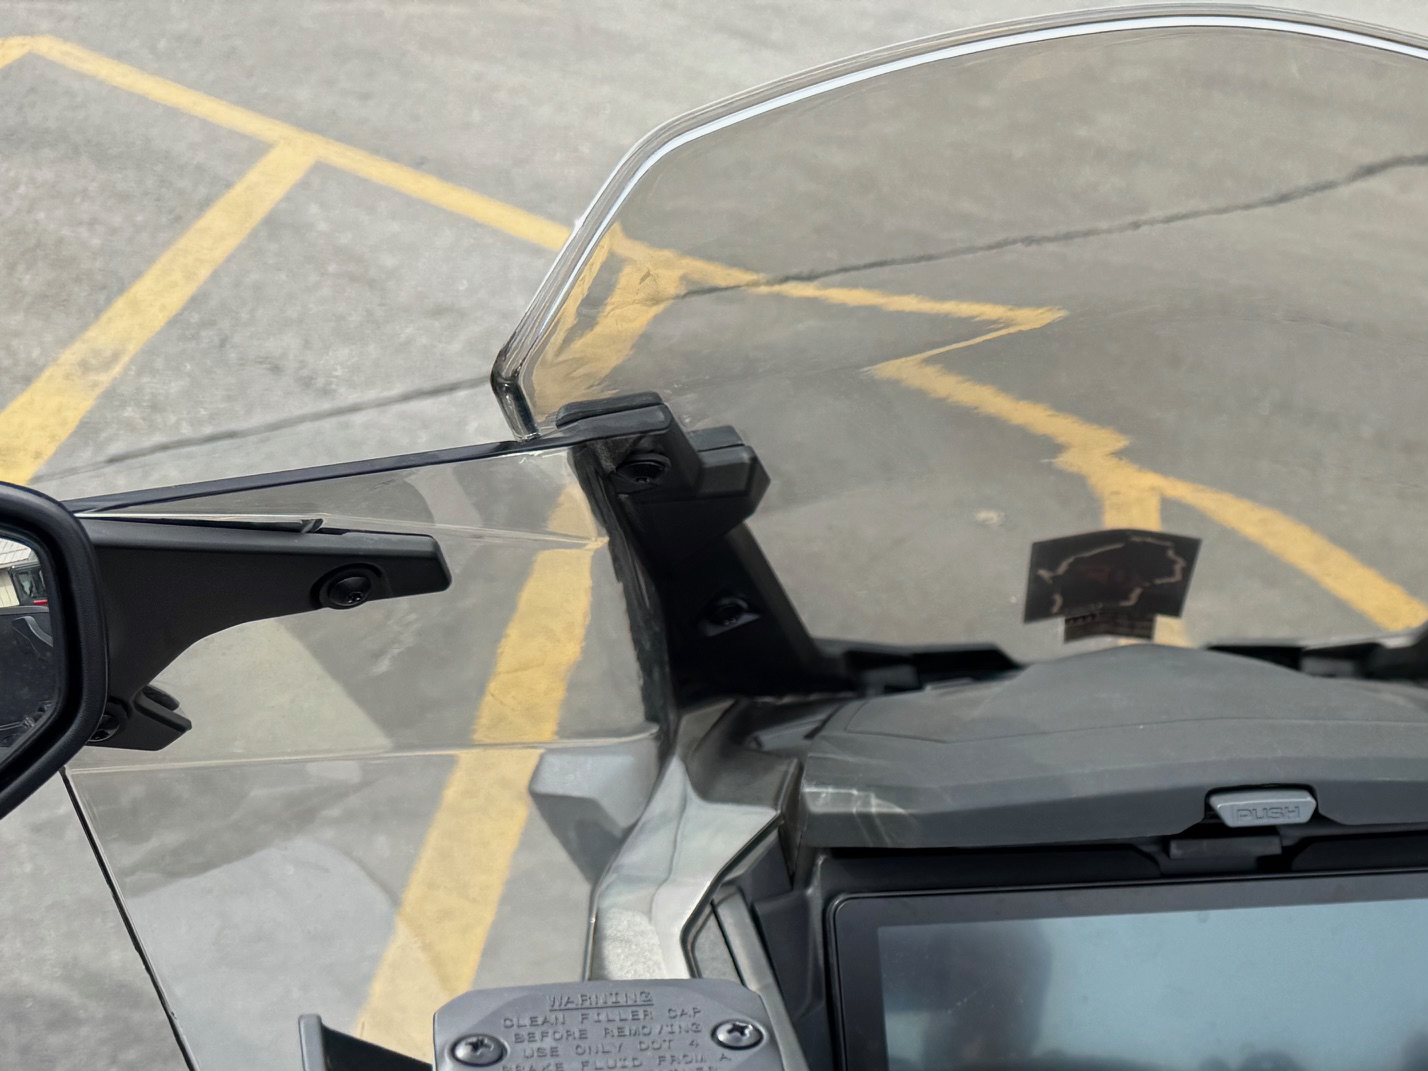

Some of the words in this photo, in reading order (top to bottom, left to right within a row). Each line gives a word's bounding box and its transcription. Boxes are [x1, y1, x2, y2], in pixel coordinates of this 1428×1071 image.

[1236, 805, 1301, 824] PUSH
[549, 991, 653, 1009] WARNING
[503, 1013, 566, 1029] CLEAN
[580, 1009, 654, 1025] FILLER
[667, 1006, 701, 1020] CAP
[514, 1028, 588, 1044] BEFORE
[603, 1021, 702, 1038] REMOVING
[523, 1045, 560, 1059] USE
[575, 1041, 623, 1056] ONLY
[638, 1039, 673, 1052] DOT
[689, 1038, 699, 1049] 4
[657, 1053, 708, 1067] FROM
[719, 1052, 732, 1063] A
